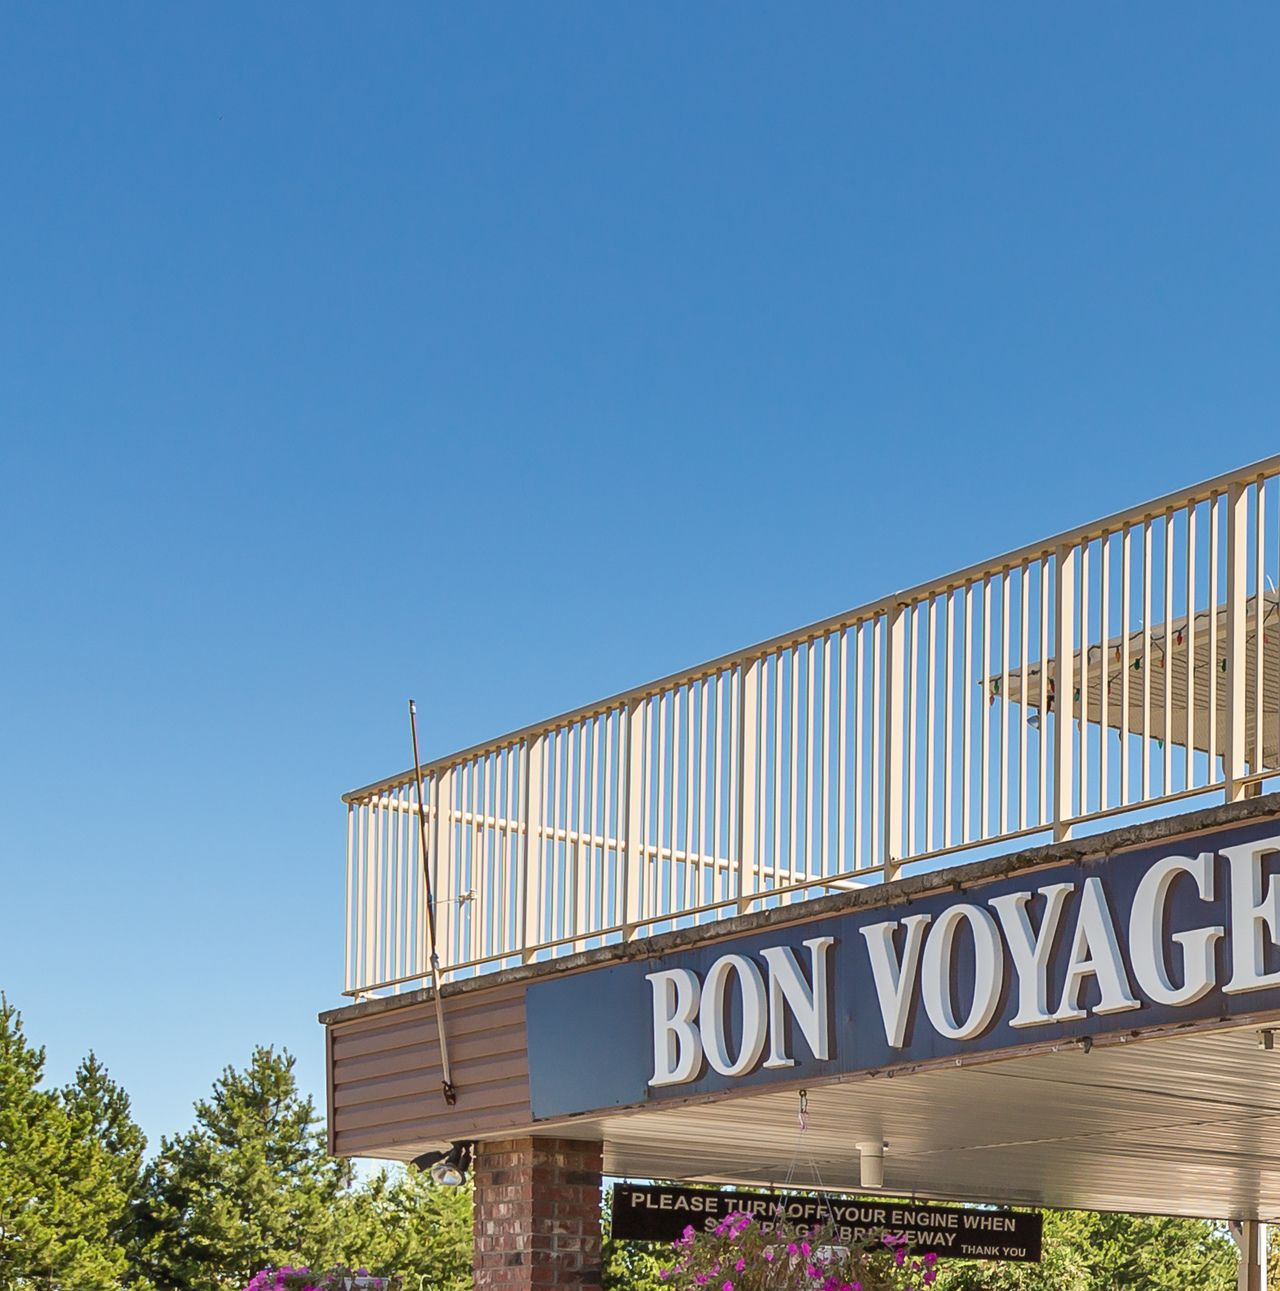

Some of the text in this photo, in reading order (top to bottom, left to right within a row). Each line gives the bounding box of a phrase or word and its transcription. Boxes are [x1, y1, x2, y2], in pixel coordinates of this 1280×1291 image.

[645, 935, 834, 1088] BON
[631, 1192, 1016, 1232] PLEASE TURN OFF YOUR ENGINE WHEN
[961, 1244, 1027, 1258] THANK YOU
